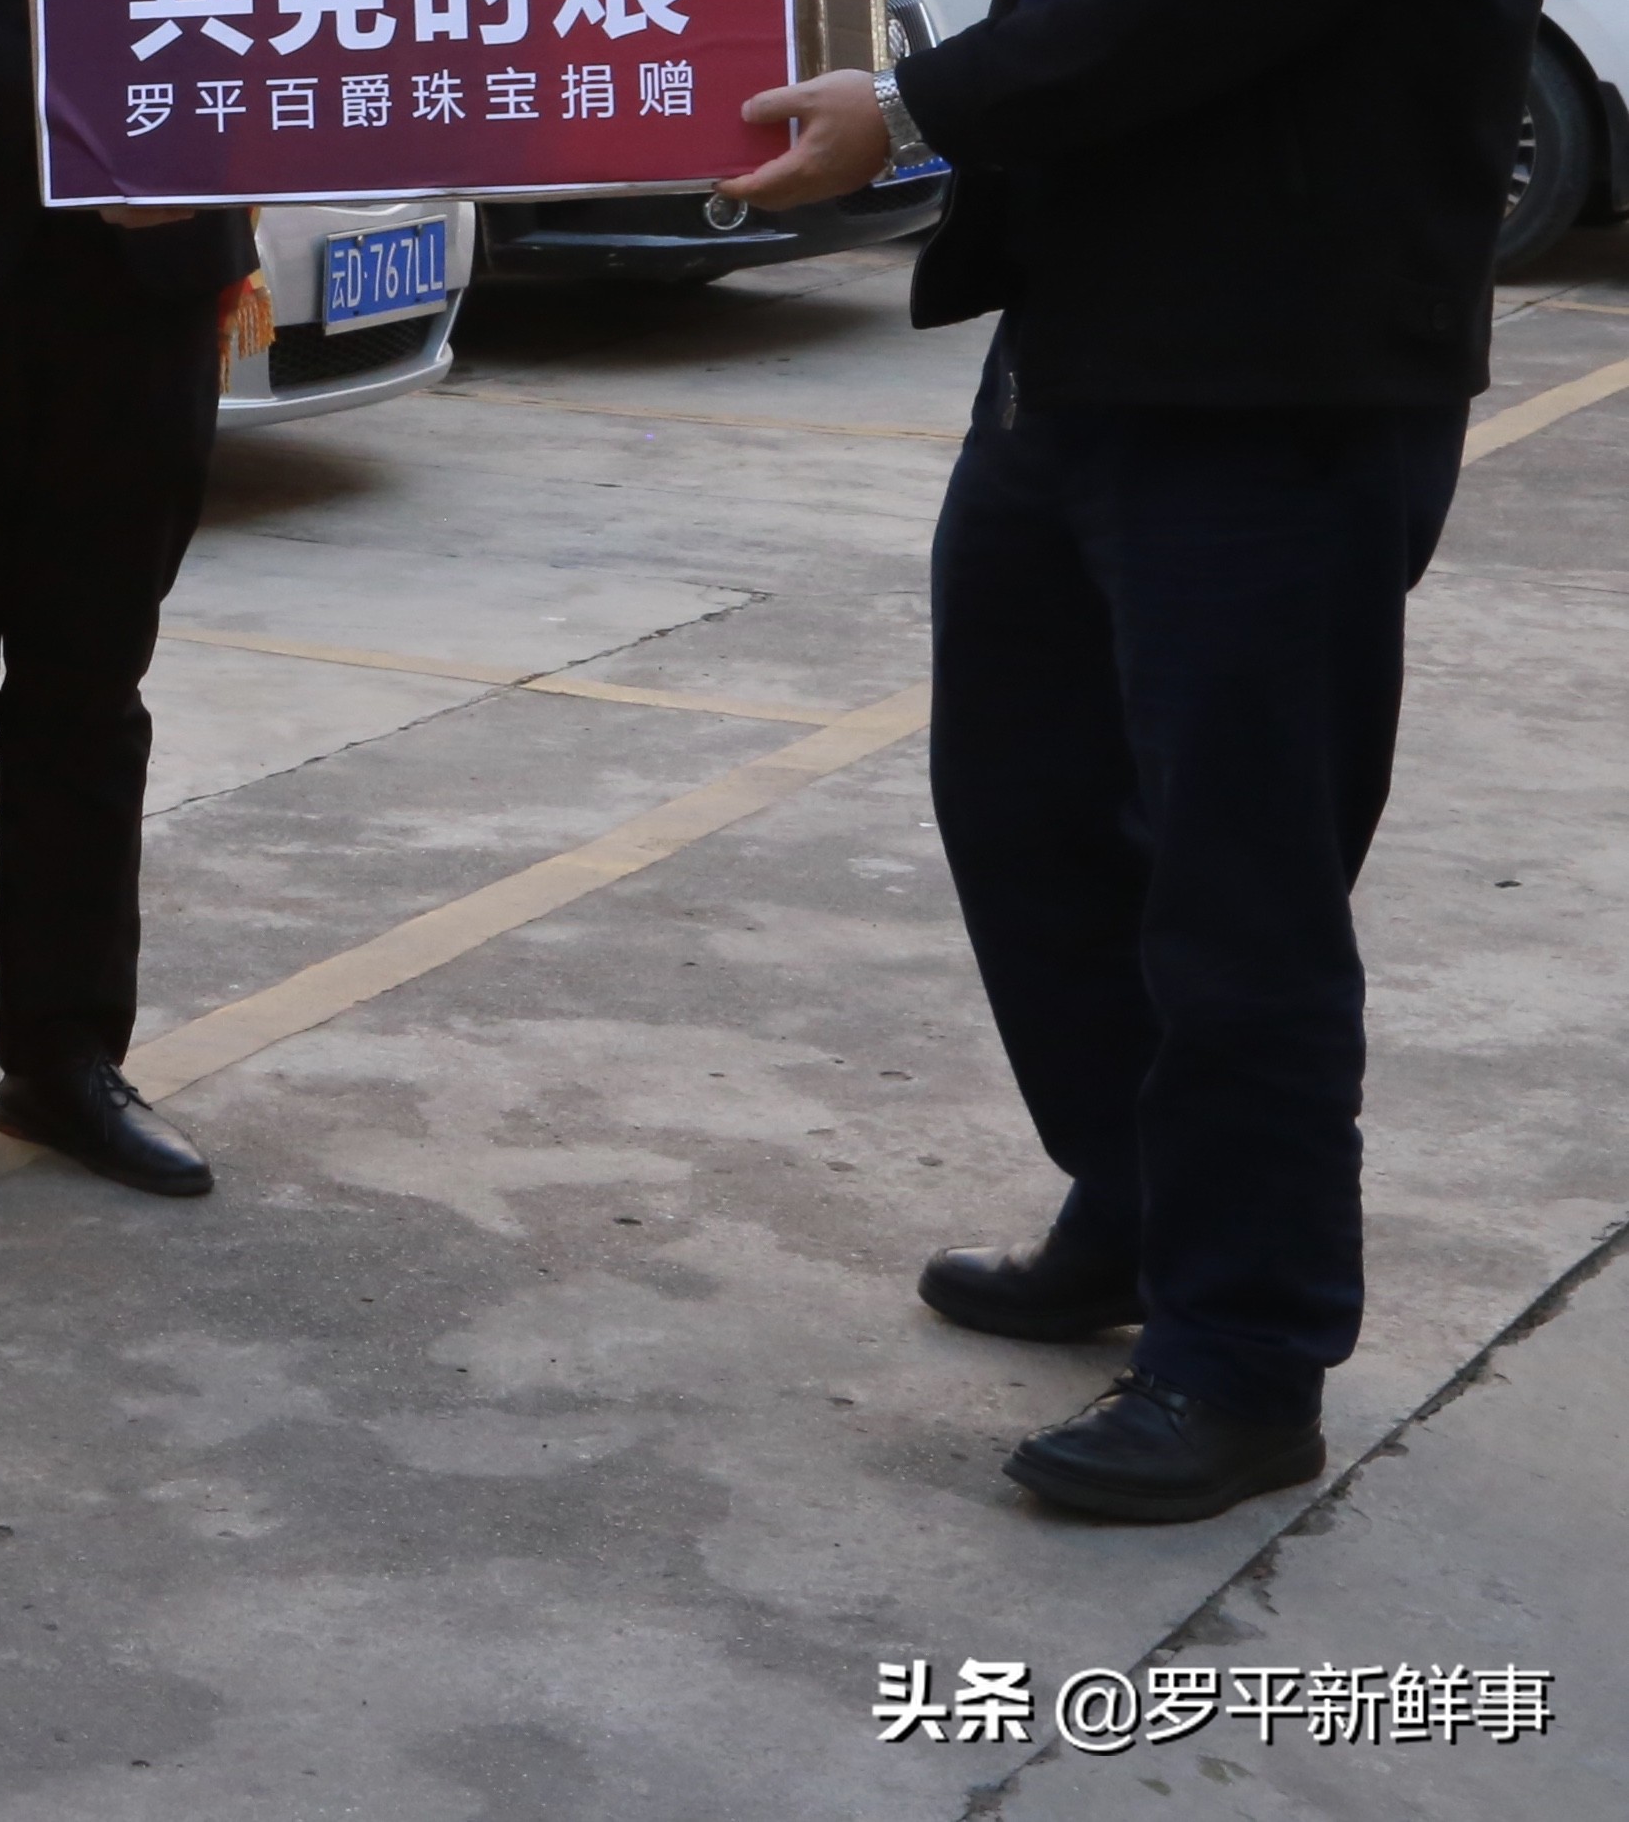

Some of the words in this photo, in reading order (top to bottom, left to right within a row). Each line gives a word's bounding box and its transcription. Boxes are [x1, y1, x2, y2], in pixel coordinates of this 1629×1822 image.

[125, 60, 694, 138] 罗平百爵珠宝捐赠
